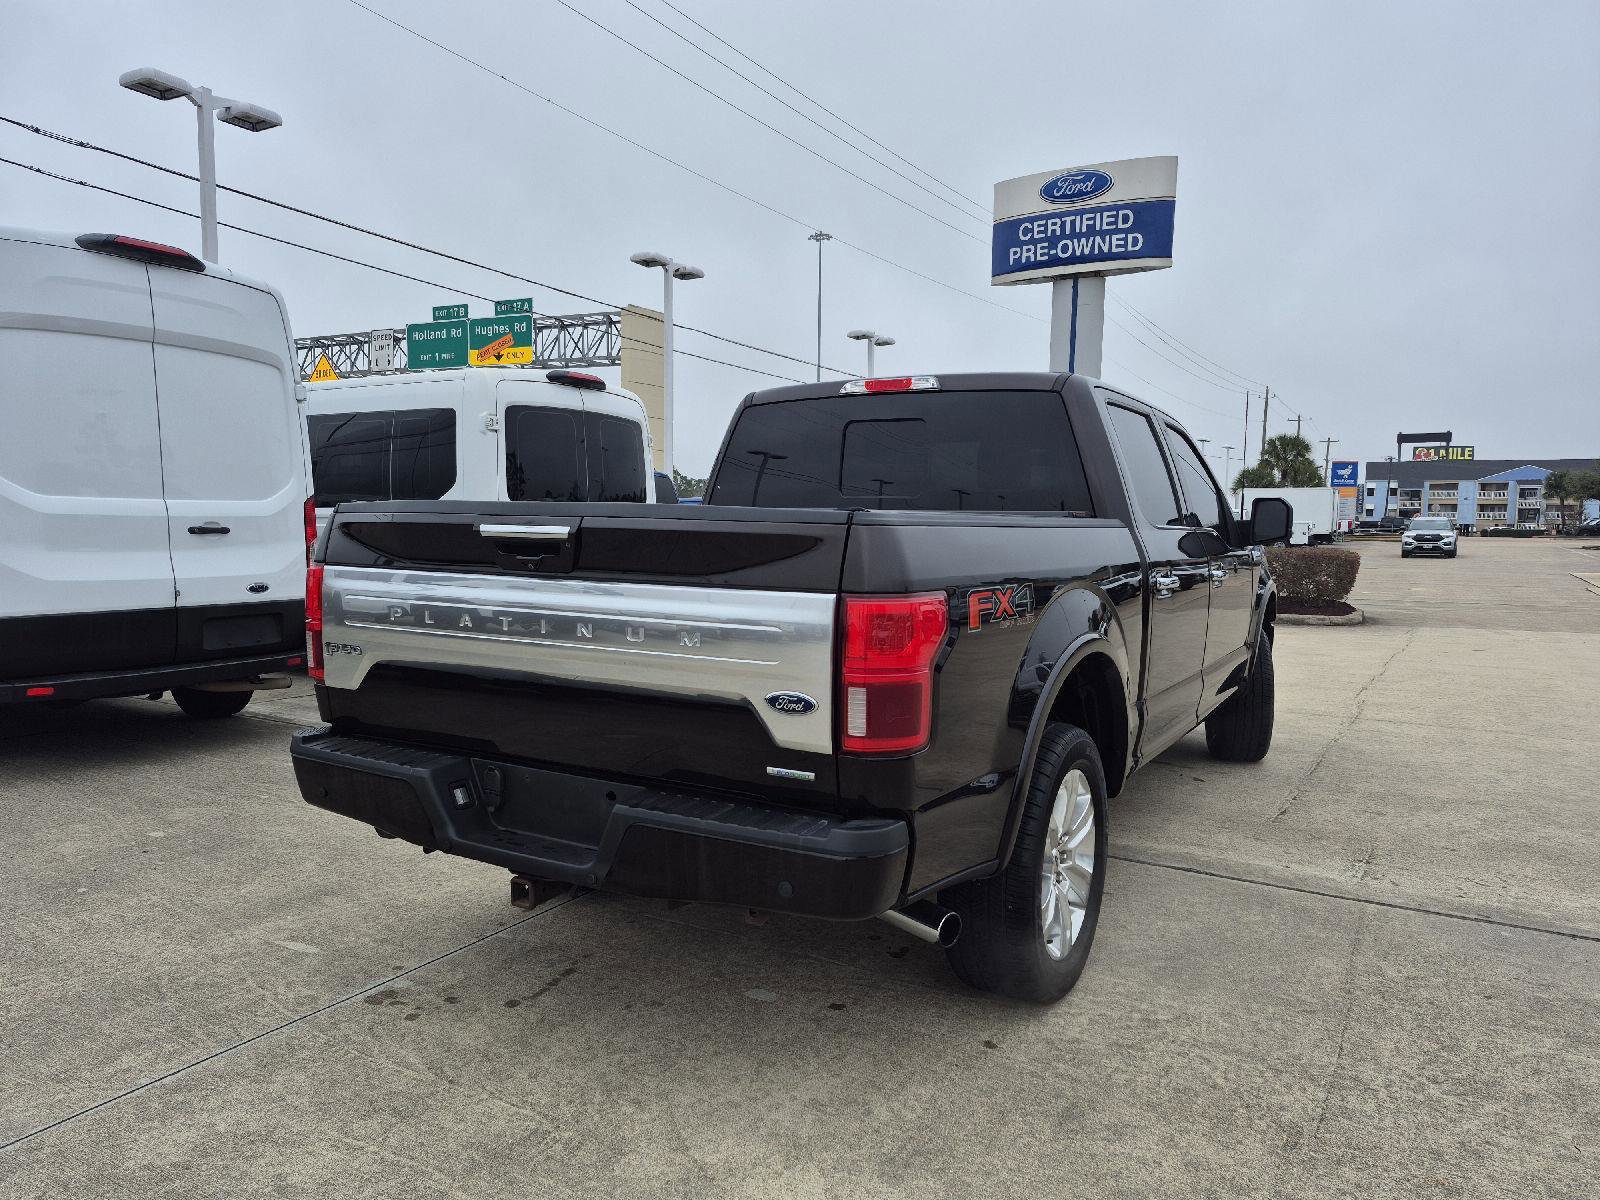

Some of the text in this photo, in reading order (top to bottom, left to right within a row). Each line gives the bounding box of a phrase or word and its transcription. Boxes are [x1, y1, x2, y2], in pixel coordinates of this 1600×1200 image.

[1018, 209, 1134, 241] CERTIFIED
[1009, 232, 1144, 266] PRE-OWNED
[372, 333, 393, 342] SPEED
[412, 327, 462, 341] Holland Rd
[475, 321, 527, 337] Hughes Rd
[374, 343, 391, 352] LIMIT
[967, 583, 1036, 633] FX4
[390, 607, 701, 647] PLATINUM
